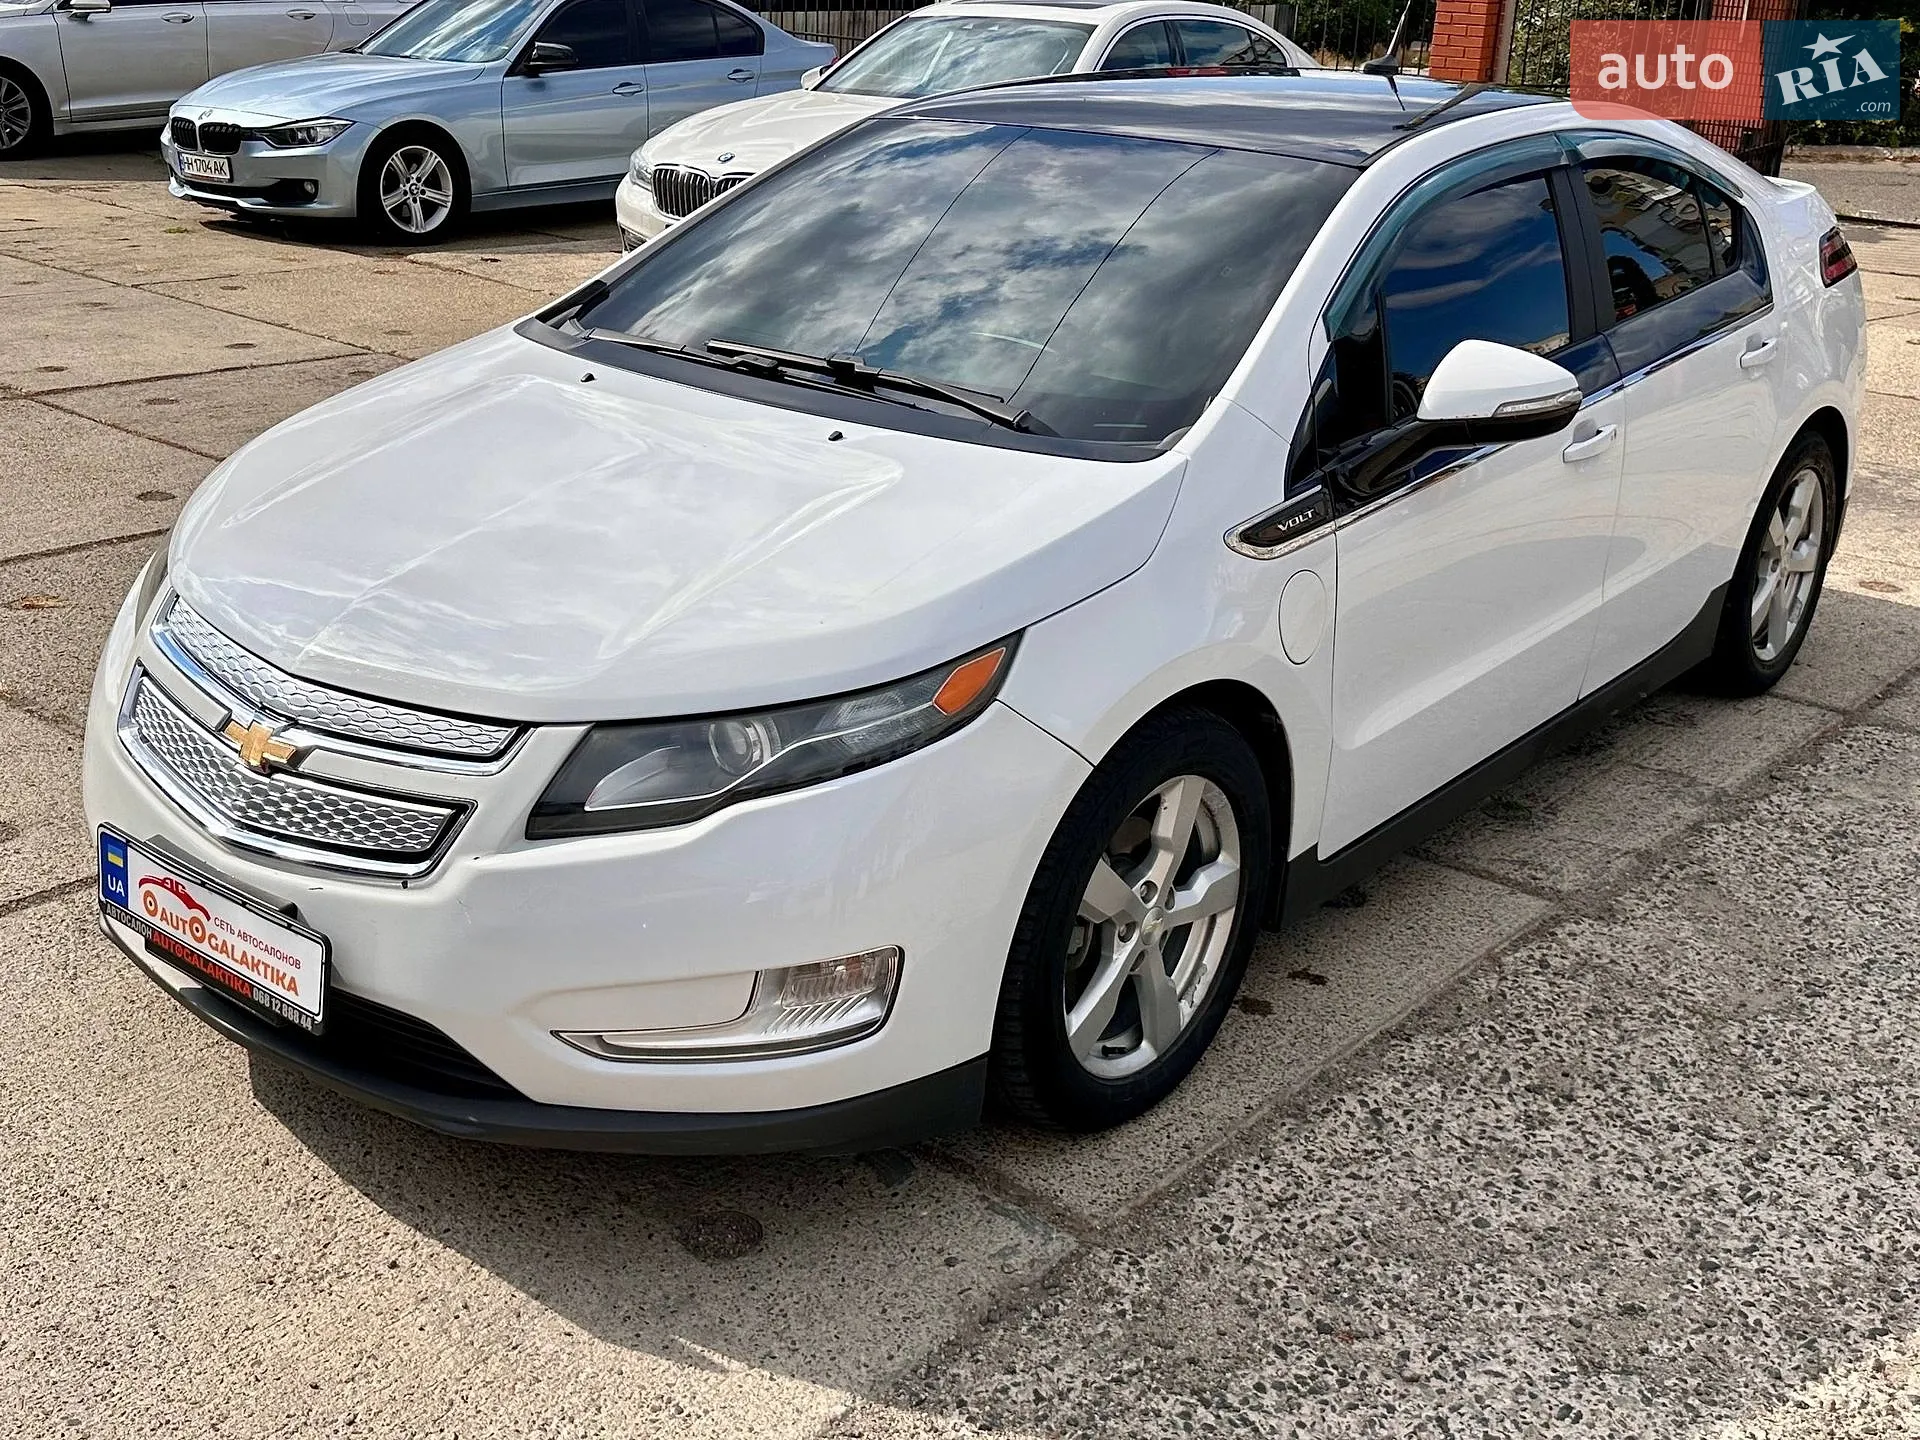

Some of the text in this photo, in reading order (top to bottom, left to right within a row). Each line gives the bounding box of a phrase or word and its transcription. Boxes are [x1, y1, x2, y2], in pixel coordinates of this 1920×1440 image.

[1277, 509, 1314, 531] VOLT
[107, 874, 125, 897] UA
[214, 917, 301, 970] СЕТЬ АВТОСАЛОНОВ
[106, 903, 152, 939] АВТОСАЛОН
[153, 930, 251, 998] AUTOGALAKTIKA
[253, 986, 270, 1007] 068
[271, 997, 281, 1013] 12
[300, 1014, 312, 1031] 44
